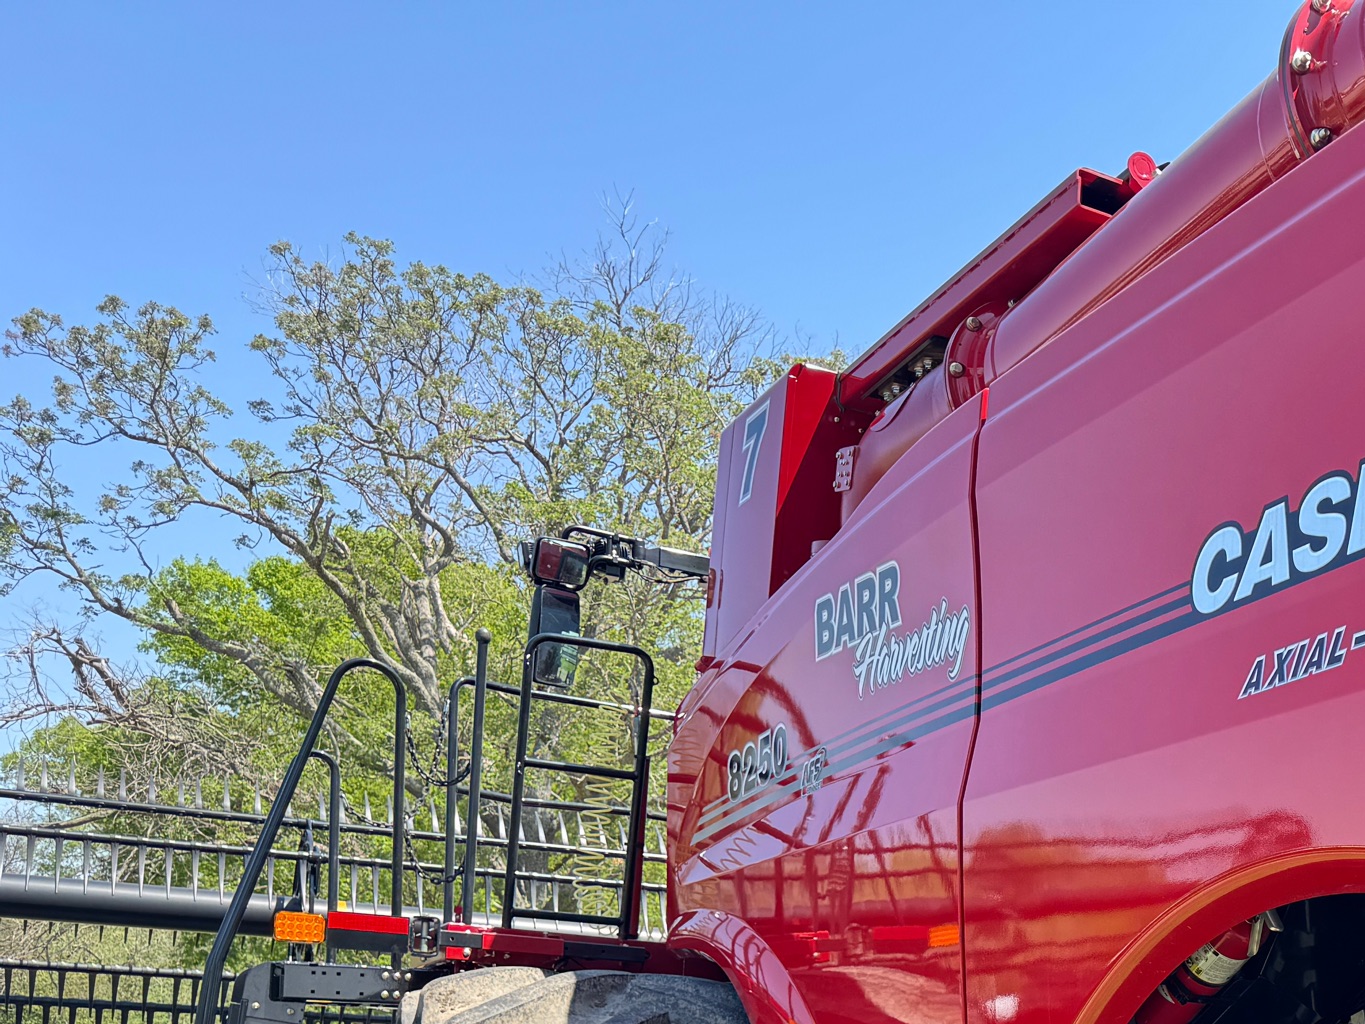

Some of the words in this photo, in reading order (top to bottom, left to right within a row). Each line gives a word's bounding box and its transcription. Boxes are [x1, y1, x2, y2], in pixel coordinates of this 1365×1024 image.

[739, 398, 770, 507] 7
[814, 560, 902, 662] BARR
[853, 596, 970, 700] Harvesting
[728, 722, 787, 803] 8250
